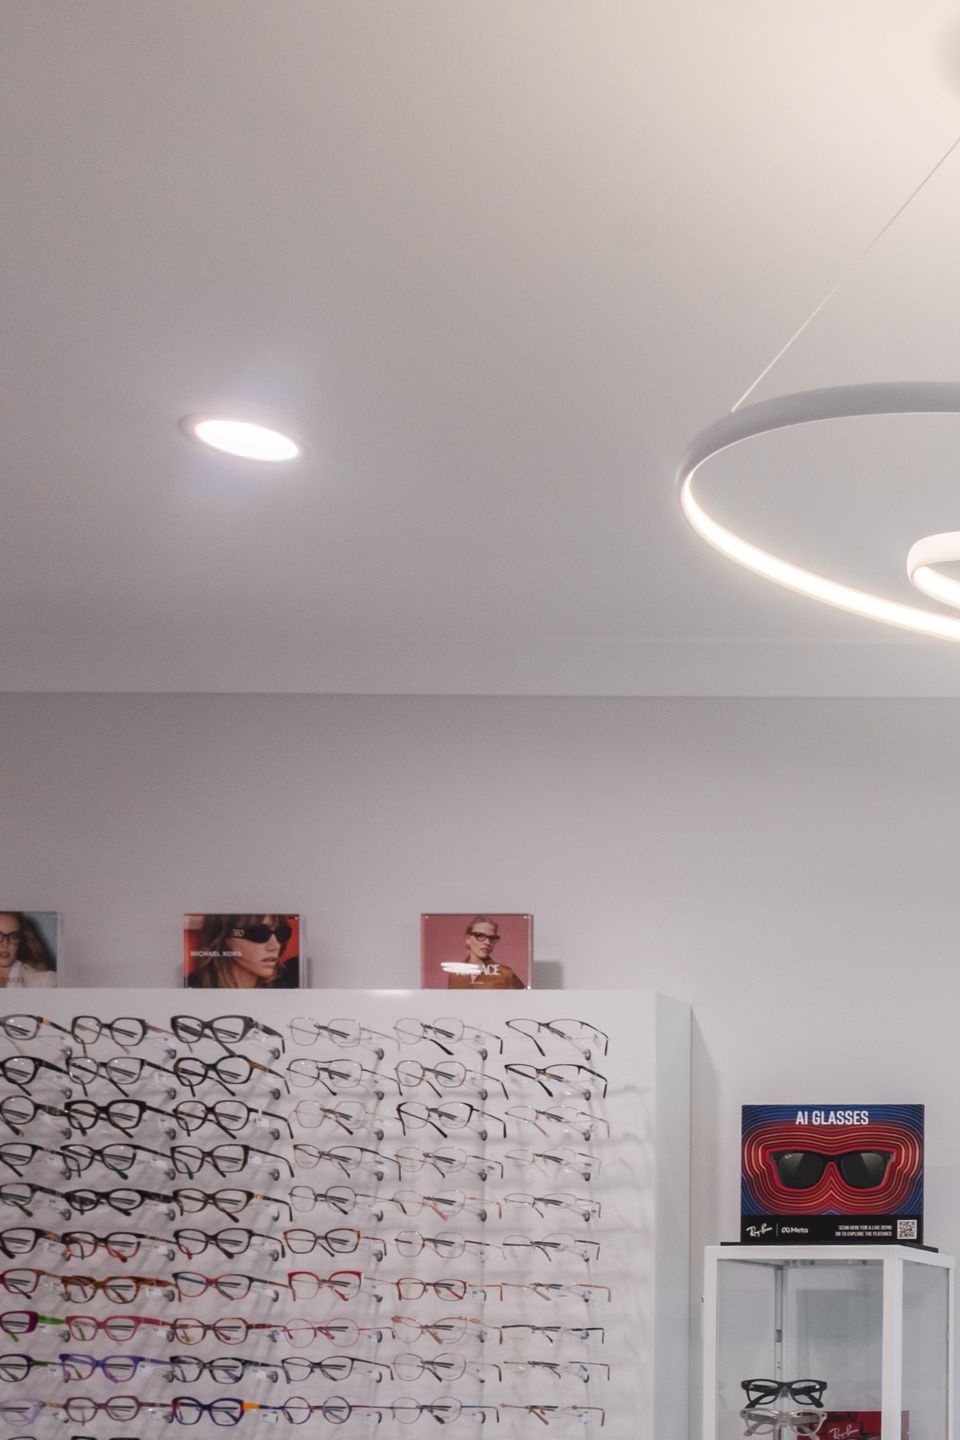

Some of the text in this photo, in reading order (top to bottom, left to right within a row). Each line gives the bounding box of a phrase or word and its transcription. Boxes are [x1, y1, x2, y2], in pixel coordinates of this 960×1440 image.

[795, 1110, 869, 1125] AI GLASSES
[829, 1424, 859, 1440] Ray-Ban
